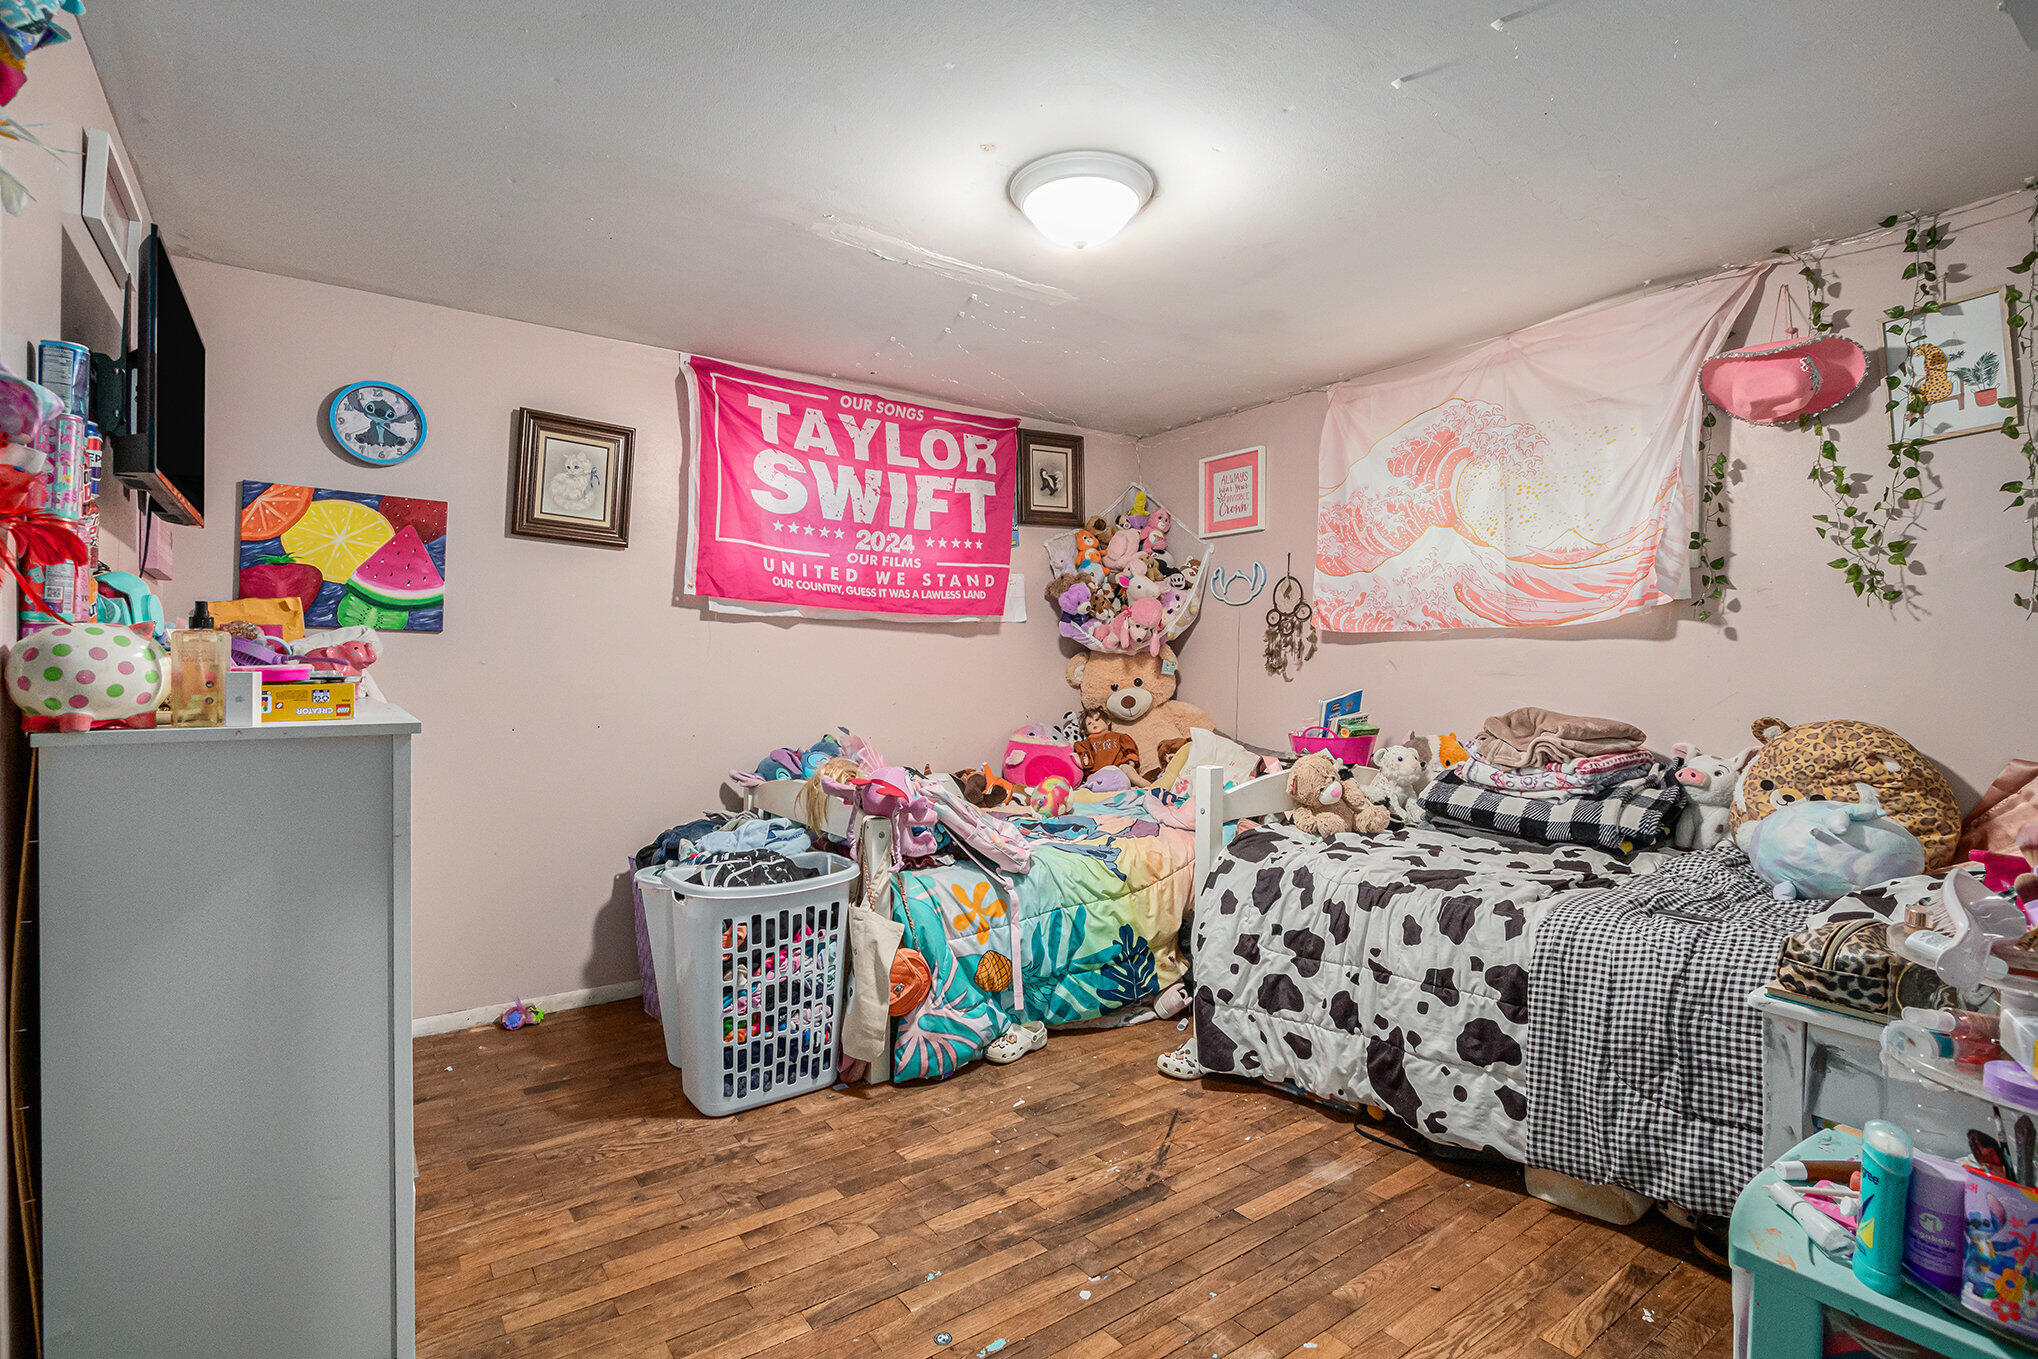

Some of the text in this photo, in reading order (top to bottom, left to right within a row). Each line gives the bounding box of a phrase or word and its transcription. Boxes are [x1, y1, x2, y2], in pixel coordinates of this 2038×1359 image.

[372, 389, 383, 397] 12
[839, 394, 925, 422] OUR SONGS
[747, 392, 997, 475] TAYLOR
[378, 451, 385, 459] 6
[1221, 472, 1248, 485] ALWAYS
[750, 448, 997, 534] SWIFT
[855, 529, 915, 554] 2024
[763, 556, 995, 588] UNITED WE STAND
[846, 553, 922, 569] OUR FILMS
[772, 576, 987, 600] OUR COUNTRY, GUESS IT WAS A LAWLESS LAND
[295, 707, 334, 715] CREATOR
